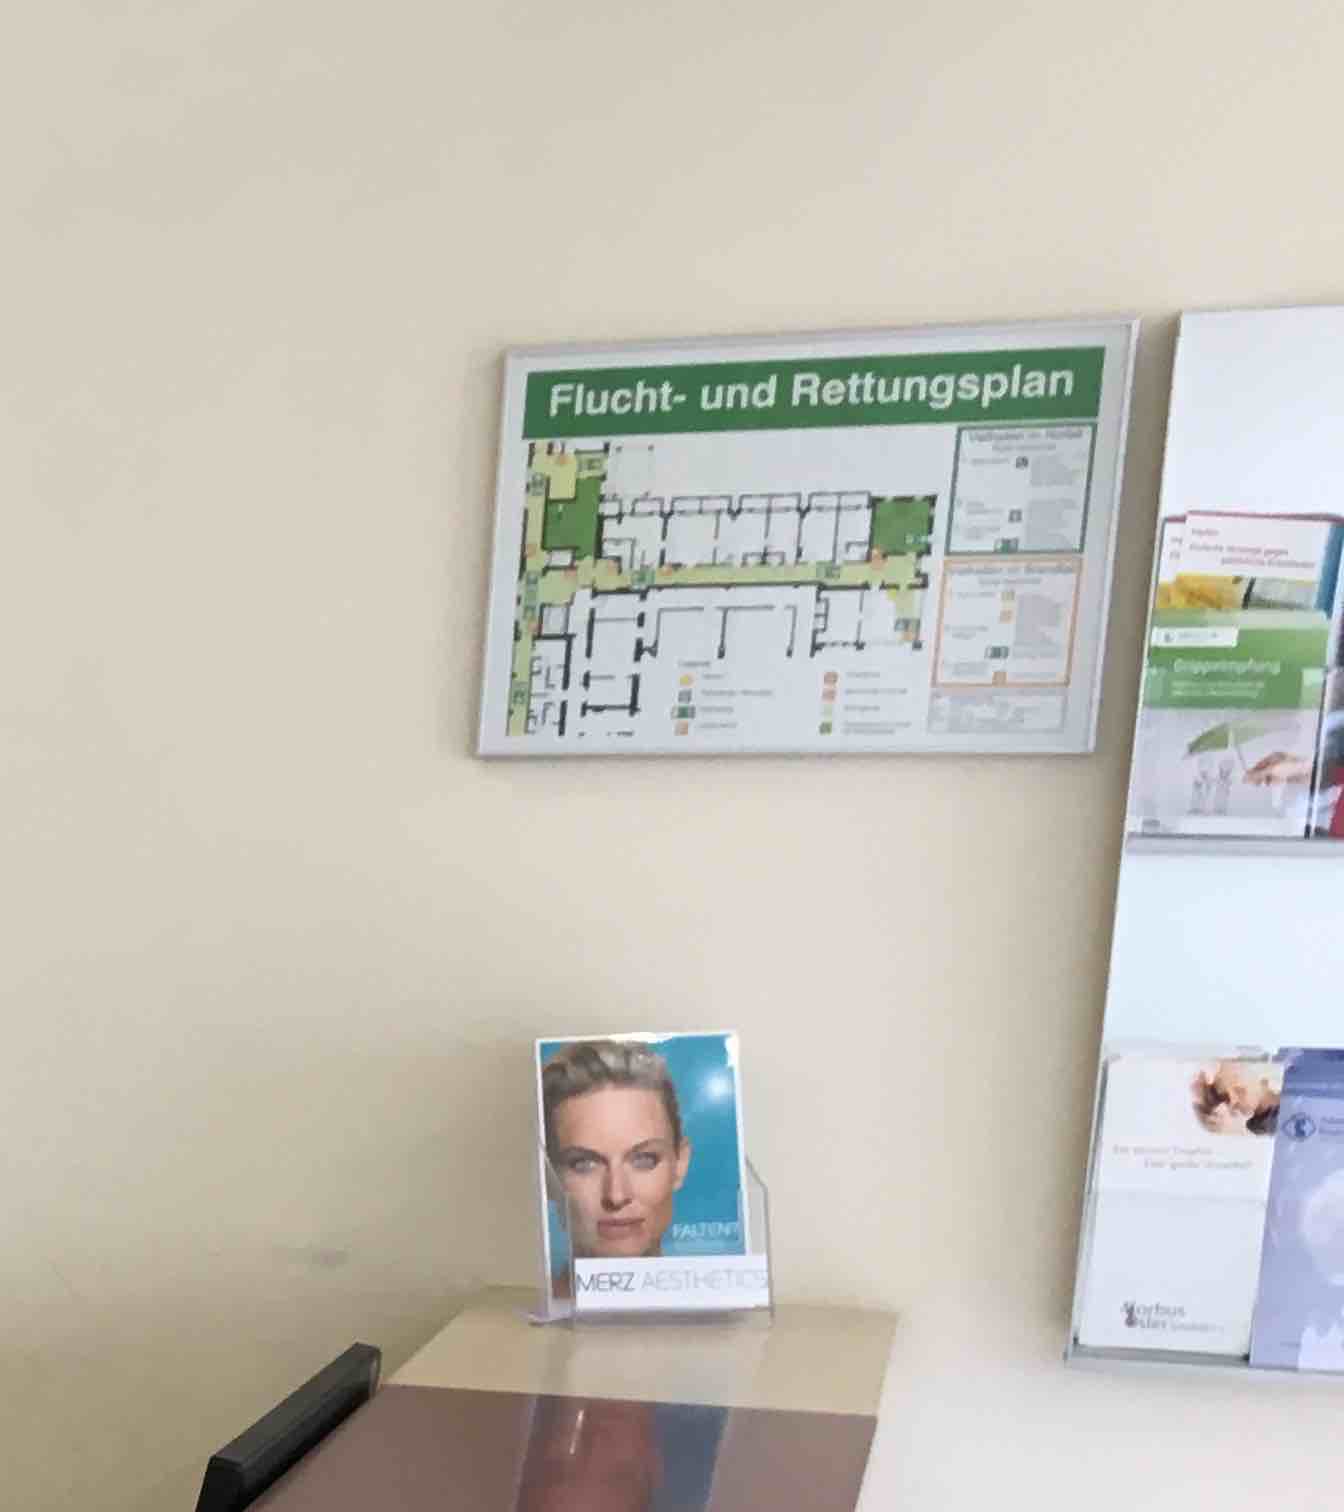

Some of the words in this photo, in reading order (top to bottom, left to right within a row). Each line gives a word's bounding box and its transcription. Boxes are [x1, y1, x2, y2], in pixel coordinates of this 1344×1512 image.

[550, 380, 687, 416] Flucht-
[700, 374, 777, 410] und
[791, 364, 1075, 411] Rettungsplan
[575, 1272, 636, 1293] MERZ
